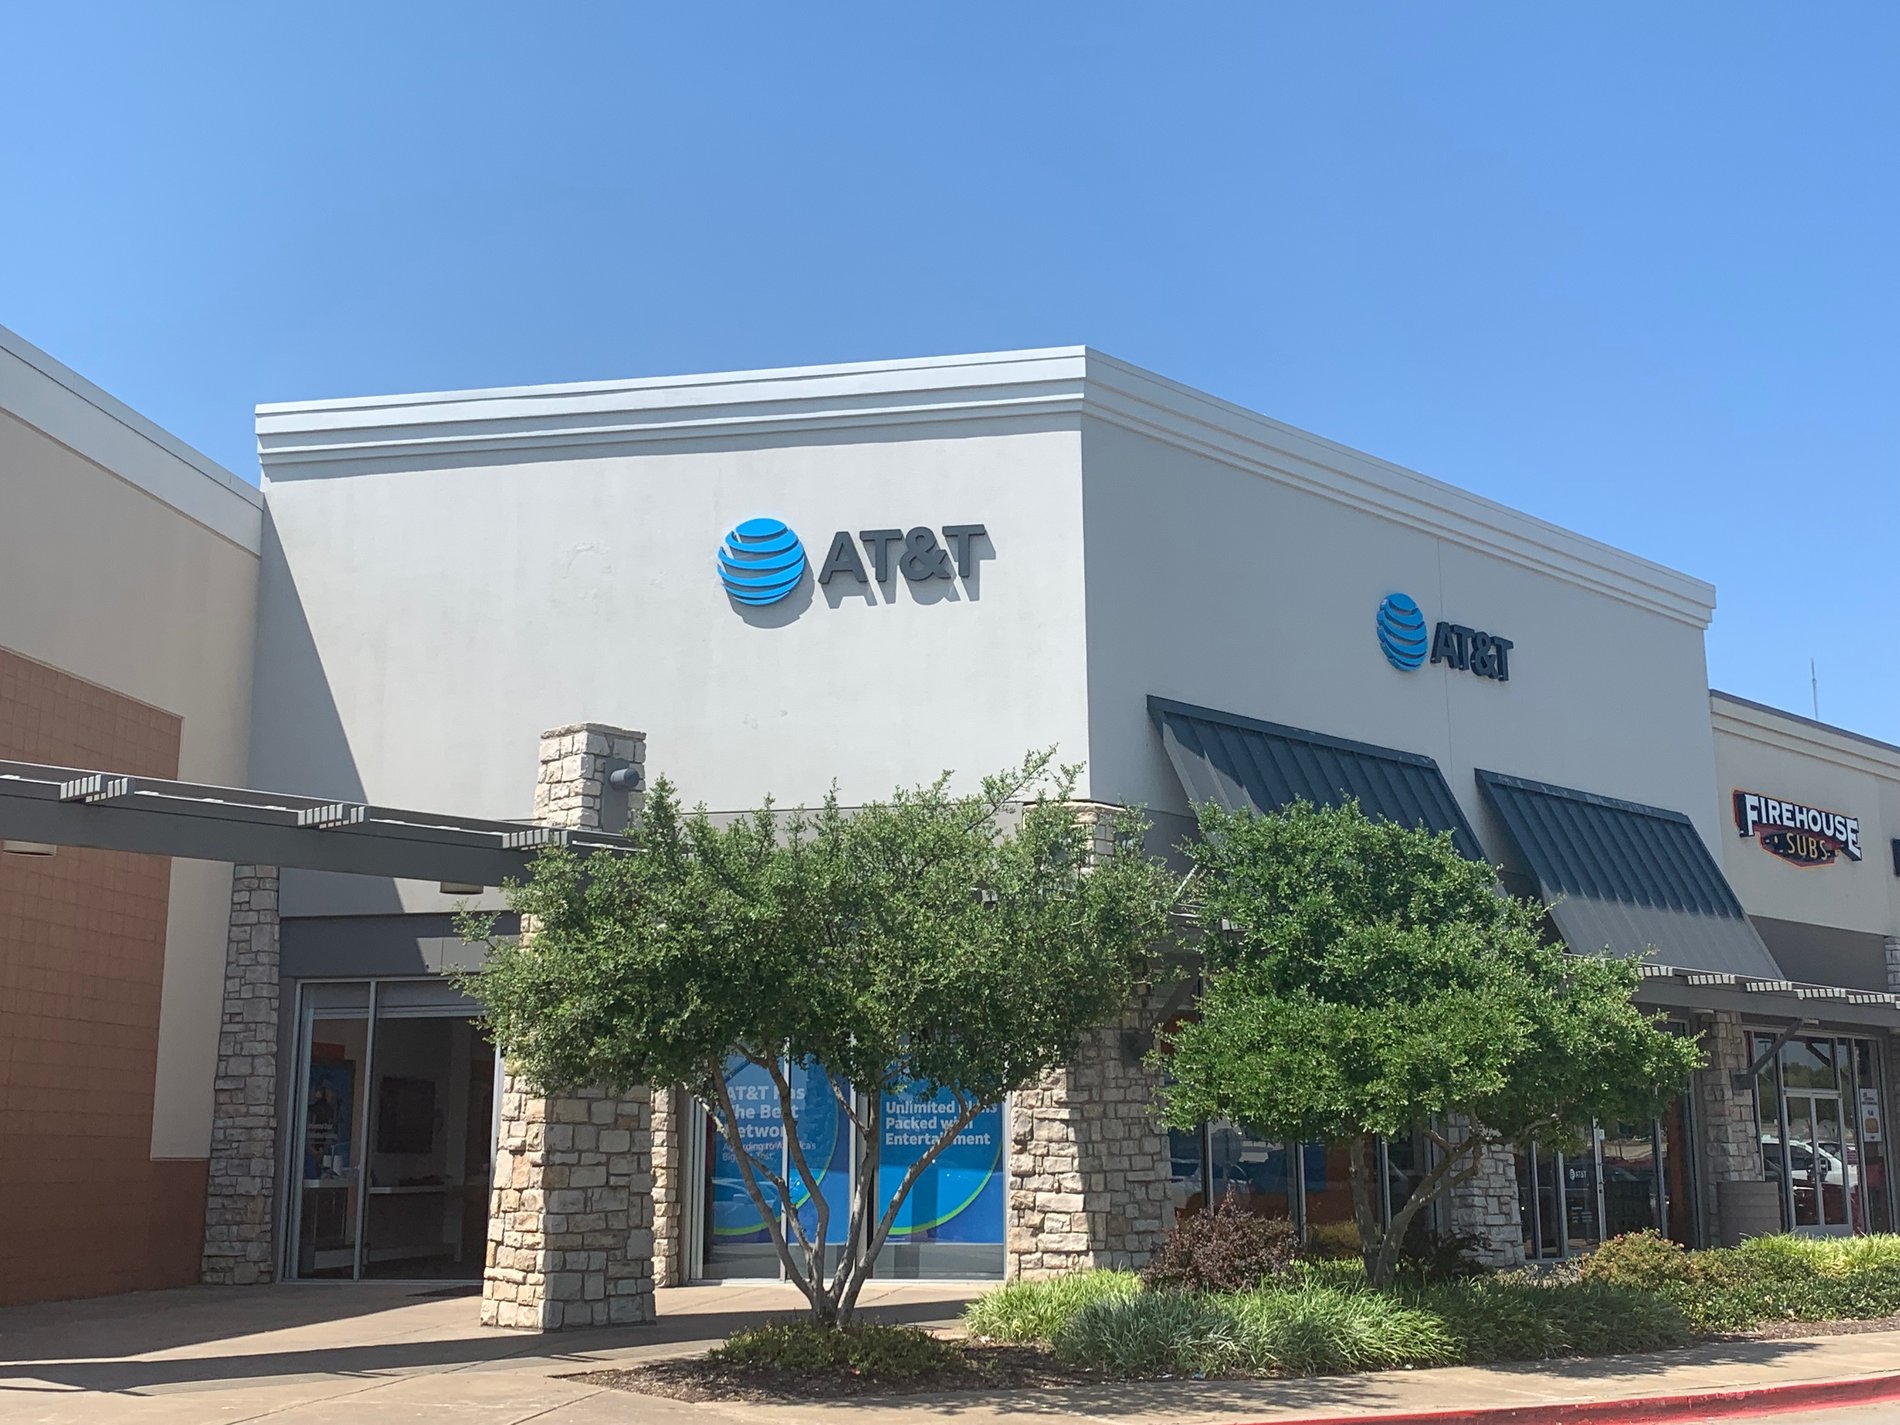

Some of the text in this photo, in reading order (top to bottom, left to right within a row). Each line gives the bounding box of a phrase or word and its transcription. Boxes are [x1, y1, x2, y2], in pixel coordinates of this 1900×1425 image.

[818, 524, 986, 584] AT&T
[1430, 621, 1514, 681] AT&T
[1744, 794, 1862, 859] FIREHOUSE
[1786, 832, 1828, 861] SUBS
[726, 1085, 769, 1100] AT&T
[728, 1104, 799, 1120] he Bet
[885, 1100, 955, 1114] Unlimited
[885, 1116, 937, 1130] Packed
[885, 1132, 991, 1146] Entertament
